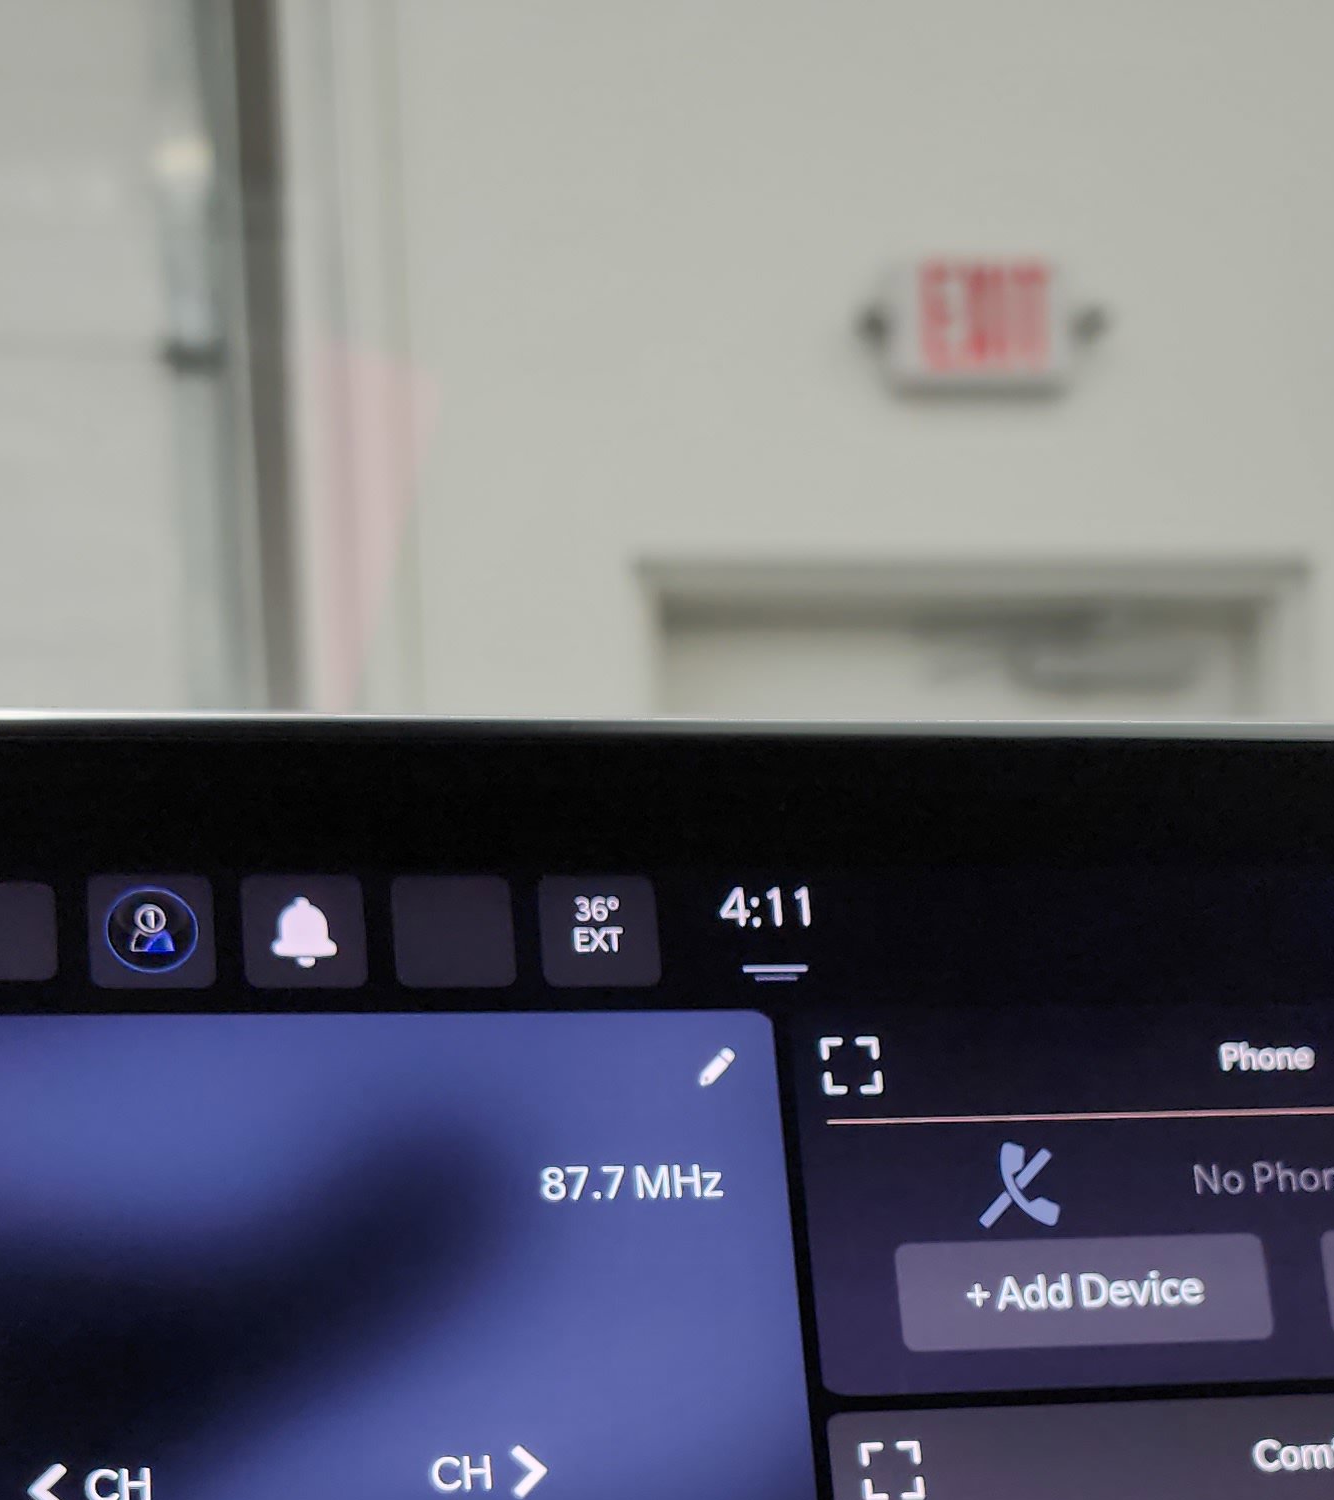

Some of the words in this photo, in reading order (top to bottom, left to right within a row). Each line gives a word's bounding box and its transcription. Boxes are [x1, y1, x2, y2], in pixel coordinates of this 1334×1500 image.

[919, 256, 1050, 370] EXIT
[719, 885, 811, 928] 4:11
[573, 926, 624, 953] EXT
[1218, 1041, 1315, 1073] Phone
[541, 1165, 625, 1201] 87.7
[634, 1163, 724, 1199] MHz
[1193, 1163, 1245, 1196] No
[1077, 1269, 1204, 1309] Device
[430, 1454, 492, 1492] CH
